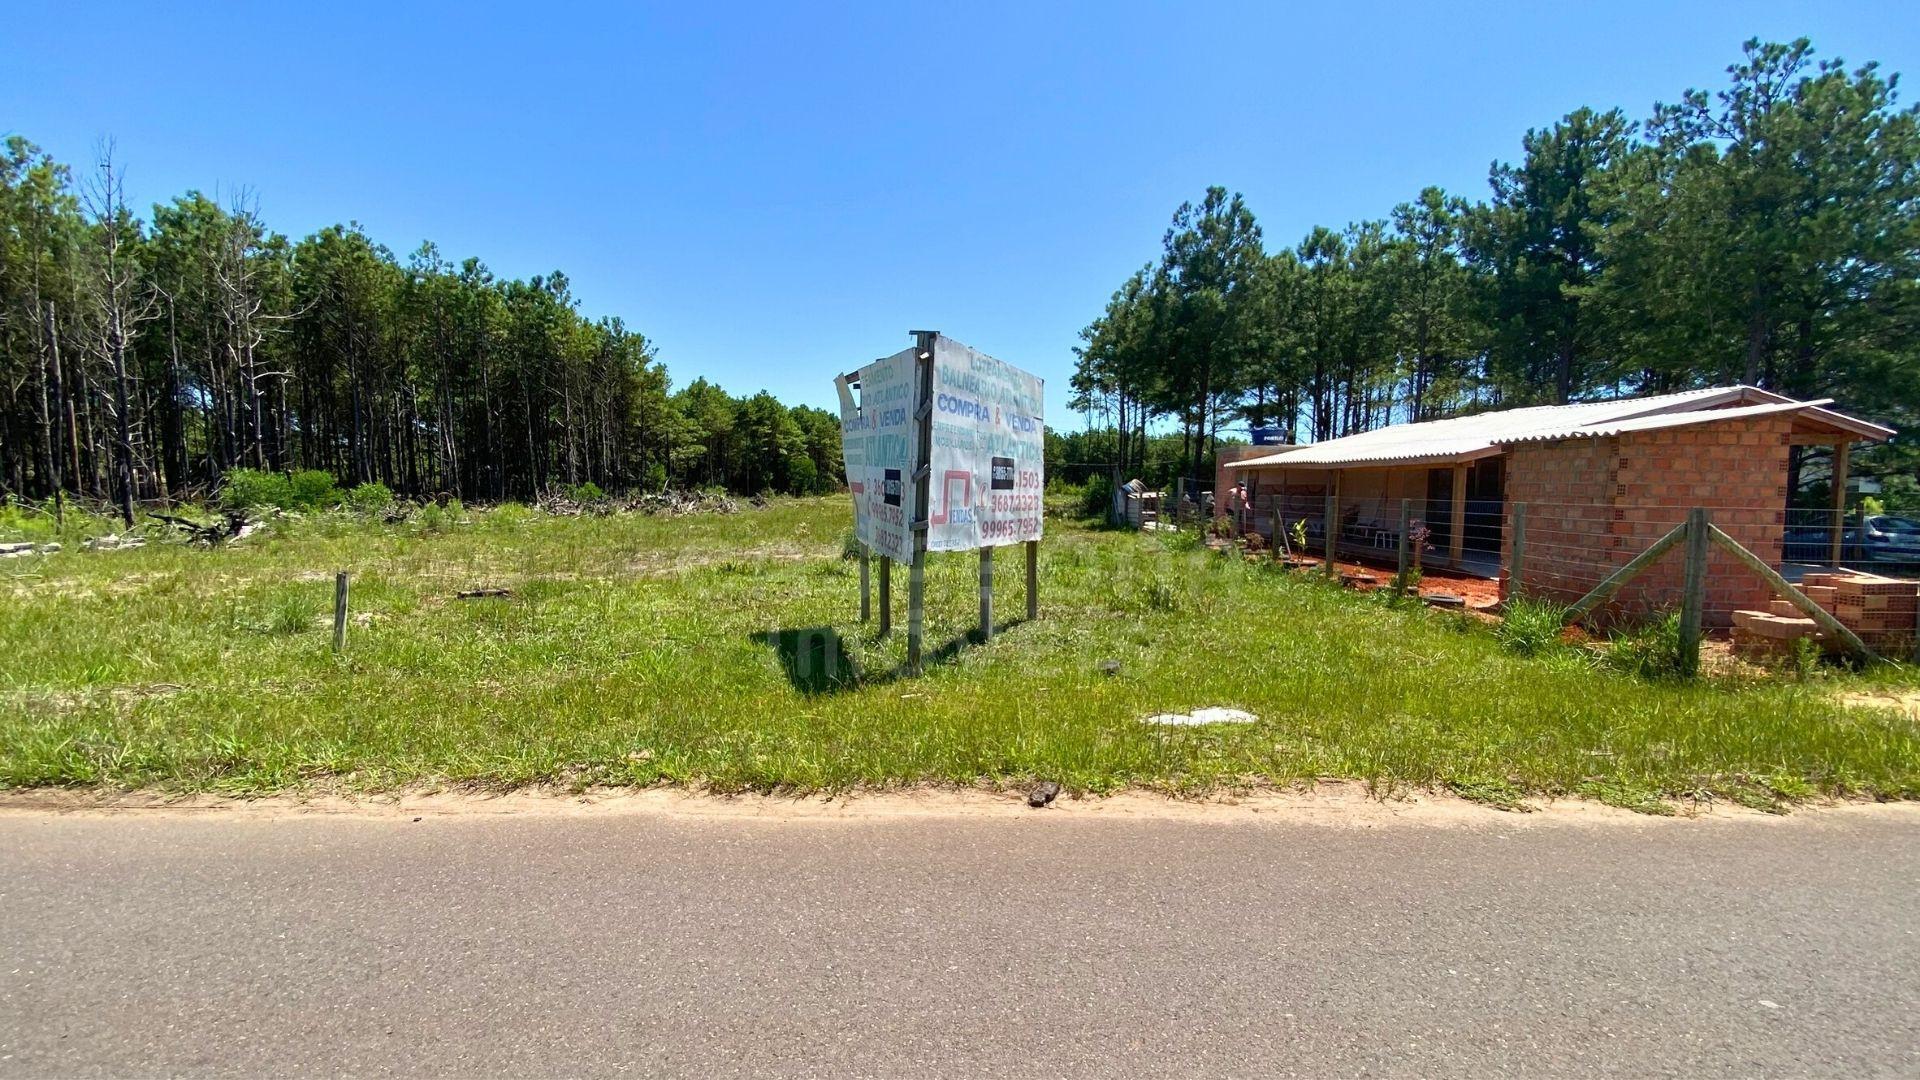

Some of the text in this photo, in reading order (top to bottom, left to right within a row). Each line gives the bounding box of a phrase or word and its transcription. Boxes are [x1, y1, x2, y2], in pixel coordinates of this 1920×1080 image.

[879, 408, 907, 428] VENDA
[937, 393, 990, 423] COMPRA
[1004, 411, 1037, 434] VENDA
[981, 517, 1039, 539] 99965.7952
